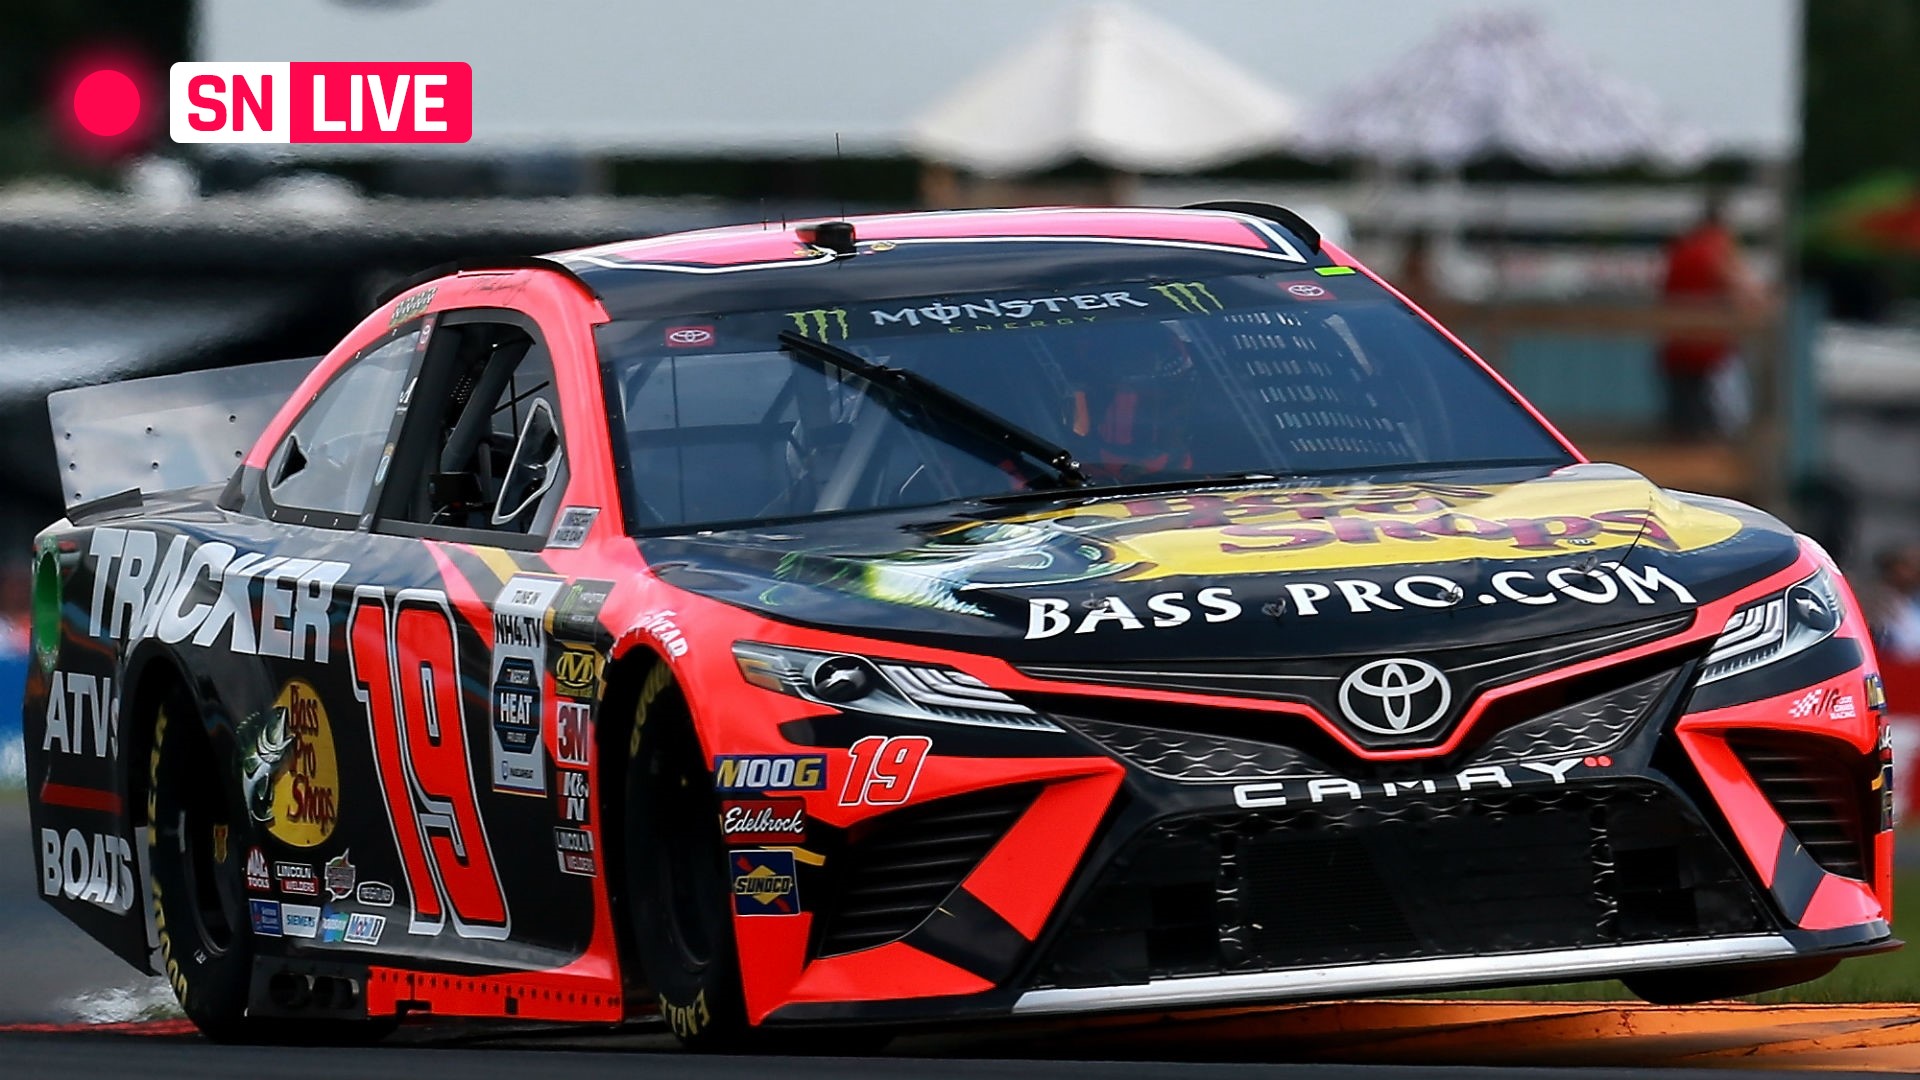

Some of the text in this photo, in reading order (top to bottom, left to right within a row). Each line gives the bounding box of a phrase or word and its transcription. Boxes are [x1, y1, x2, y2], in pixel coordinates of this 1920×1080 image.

[871, 290, 1149, 327] MONSTER
[948, 315, 1097, 334] ENERGY
[89, 527, 352, 664] TRACKER
[1023, 560, 1697, 640] BASS PRO.COM
[500, 692, 534, 725] HEAT
[558, 704, 589, 762] 3M
[346, 584, 512, 941] 19
[716, 757, 823, 789] MOOG
[838, 736, 933, 807] 19
[1233, 757, 1585, 809] CAMRY
[286, 772, 335, 836] Shops
[724, 806, 805, 834] Edelbrock
[41, 827, 134, 911] BOATS
[247, 876, 270, 889] TOOLS
[276, 864, 312, 879] LINCOLN
[285, 881, 316, 893] WELDERS
[735, 876, 790, 894] SUNOCO
